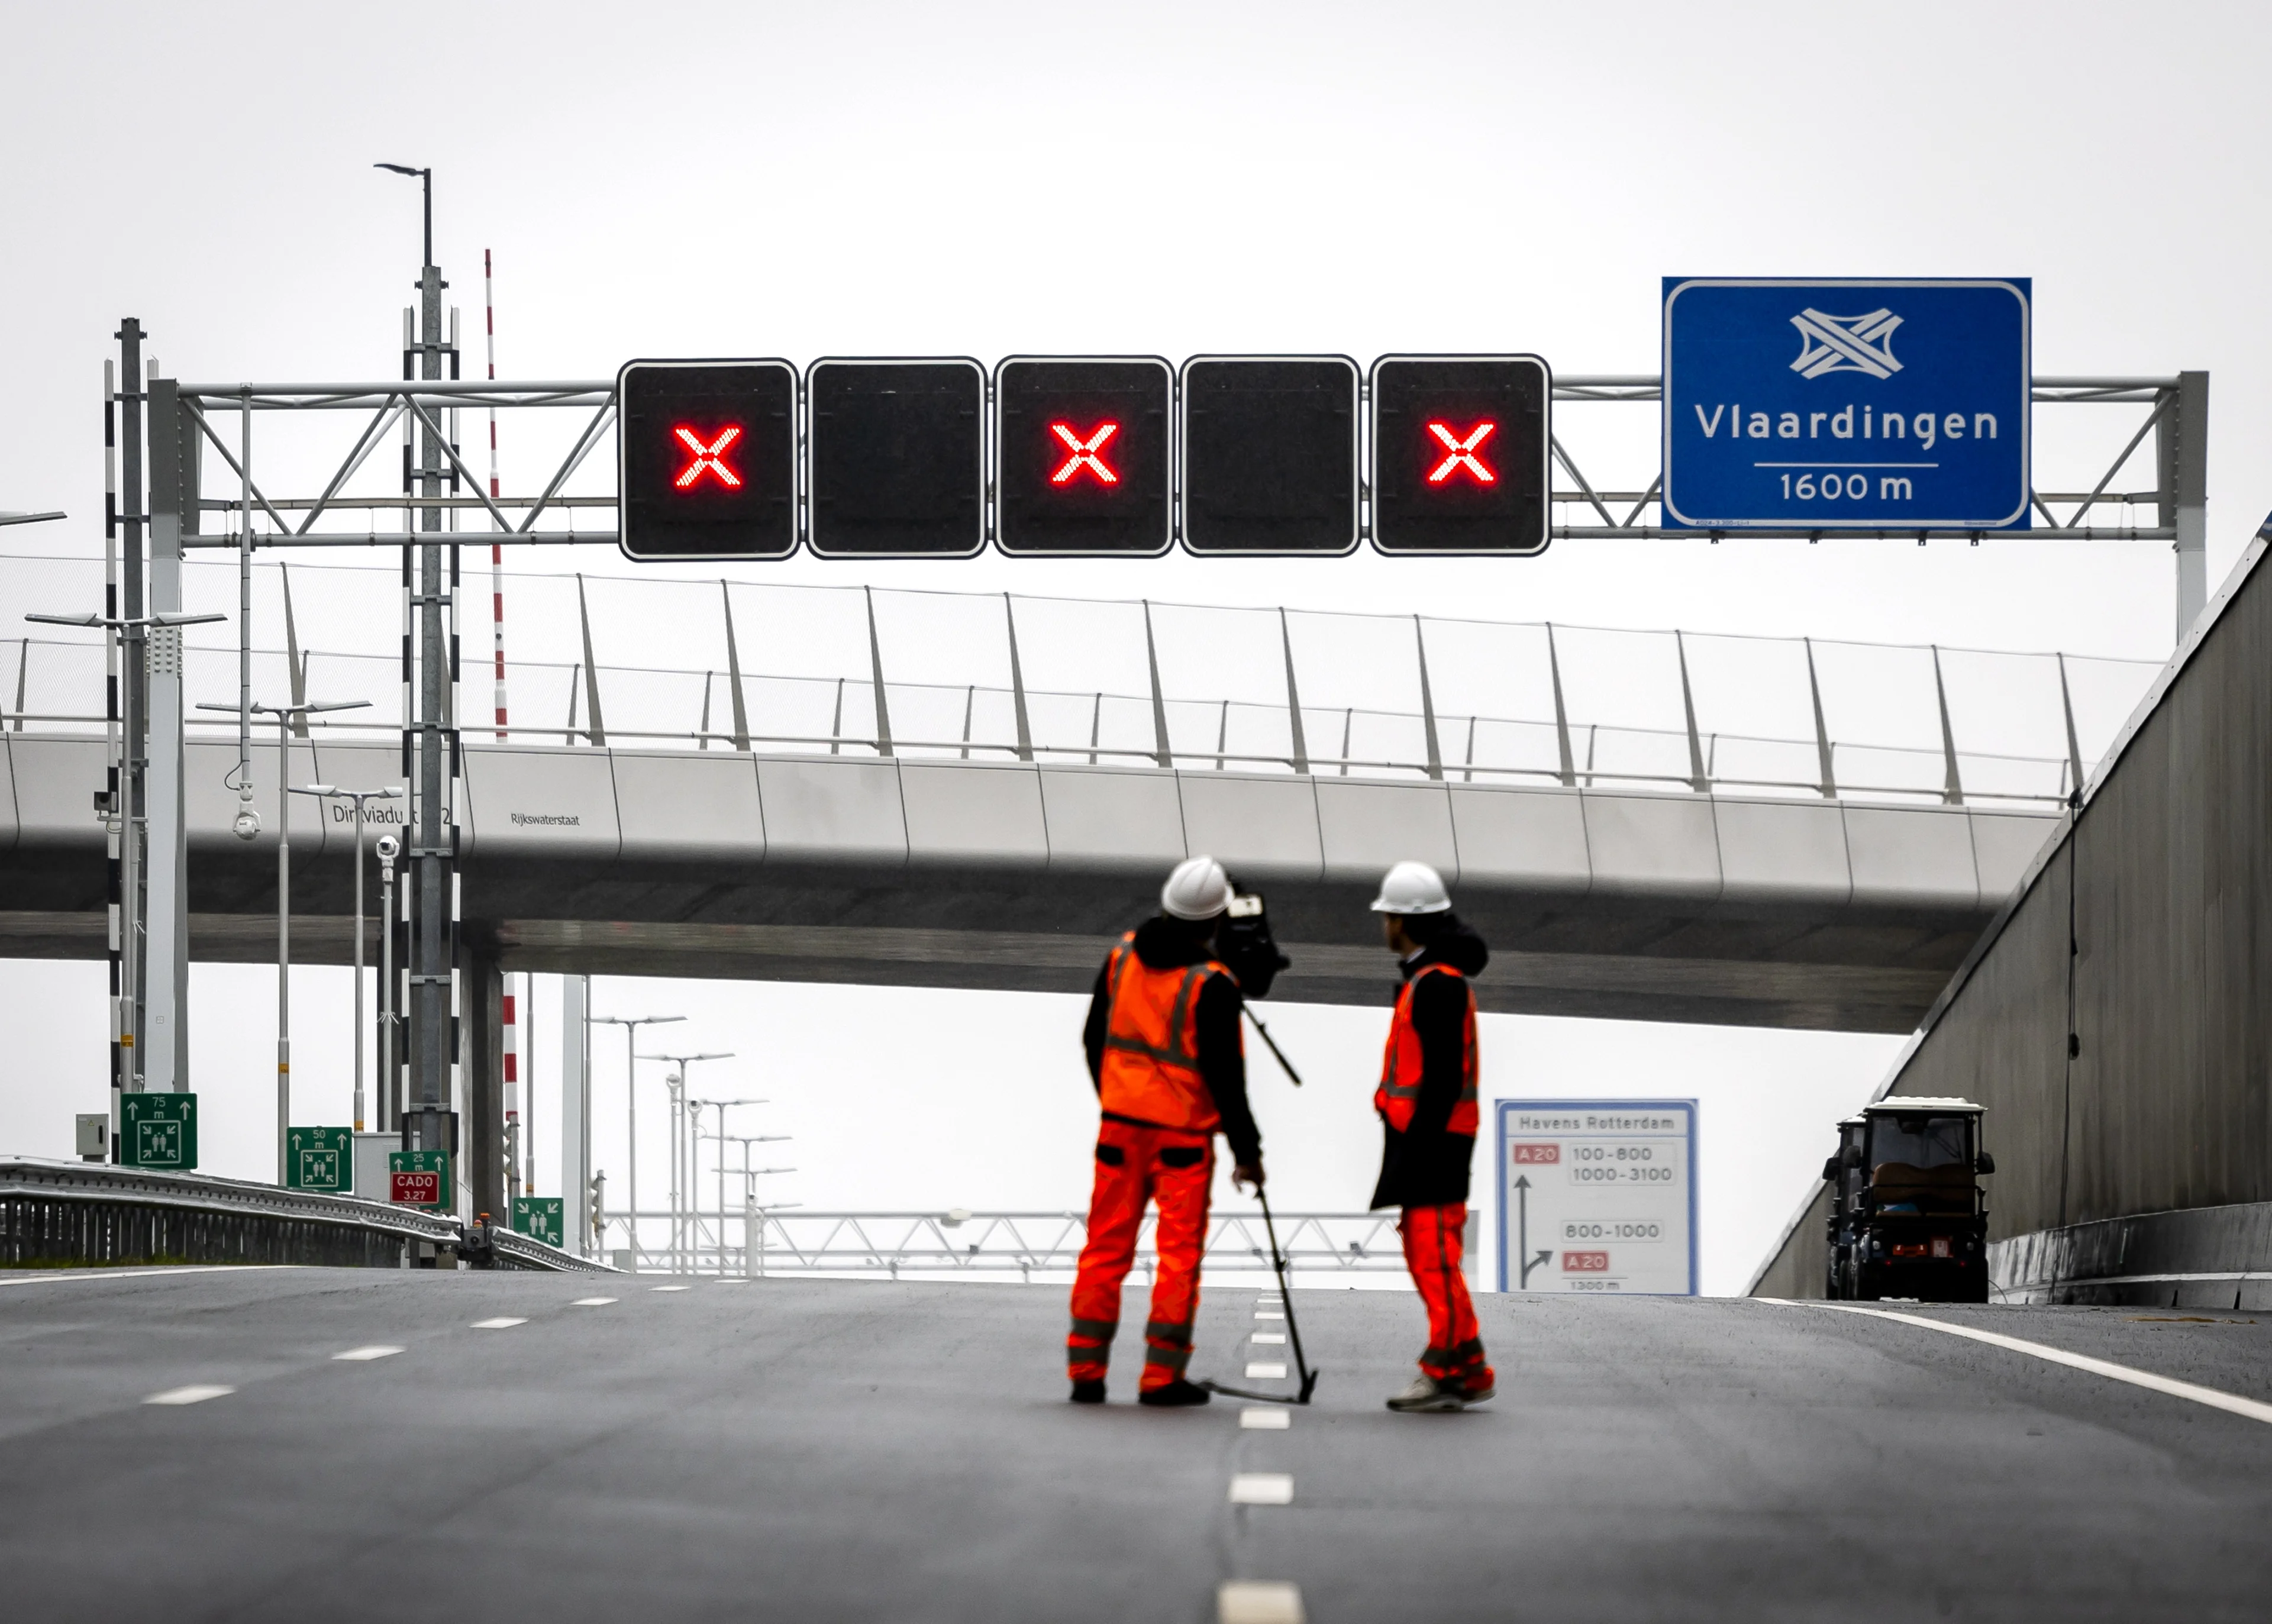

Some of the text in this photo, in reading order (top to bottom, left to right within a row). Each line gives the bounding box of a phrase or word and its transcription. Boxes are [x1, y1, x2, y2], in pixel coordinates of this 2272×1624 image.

[1695, 404, 1997, 450] Vlaardingen
[1780, 474, 1912, 499] 1600 m
[511, 813, 580, 827] Rijkswaterstaat
[152, 1097, 166, 1107] 75
[1520, 1116, 1674, 1129] Havens Rotterdam
[313, 1129, 326, 1139] 50
[413, 1154, 424, 1163] 25
[1573, 1148, 1653, 1161] 100-800
[1573, 1168, 1672, 1181] 1000-3100
[397, 1176, 433, 1187] CADO
[404, 1191, 426, 1200] 3.27
[1566, 1225, 1659, 1238] 800-1000
[1571, 1281, 1620, 1290] 1300 m
